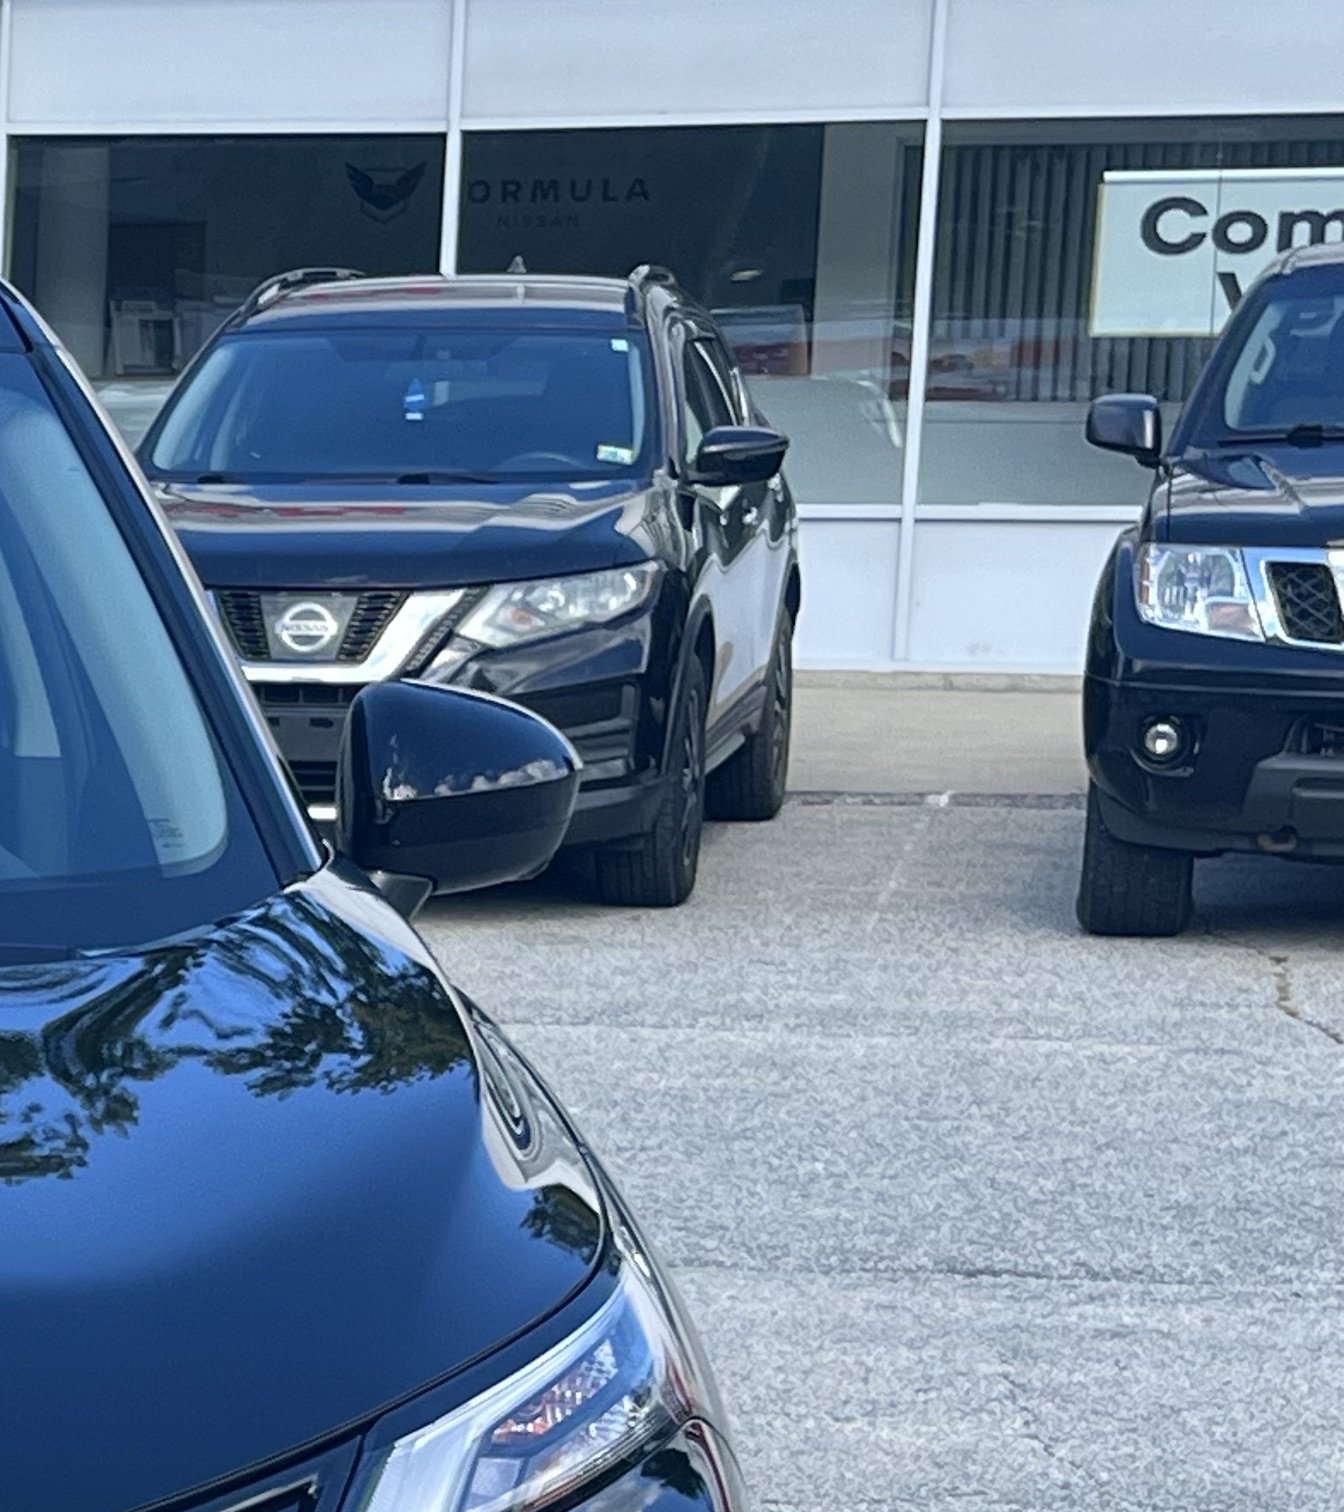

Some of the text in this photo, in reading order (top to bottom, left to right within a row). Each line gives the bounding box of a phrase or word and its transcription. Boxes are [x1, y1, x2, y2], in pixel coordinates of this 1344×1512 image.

[468, 177, 651, 204] ORMULA
[496, 214, 581, 228] NISSAN
[1140, 196, 1344, 255] Com
